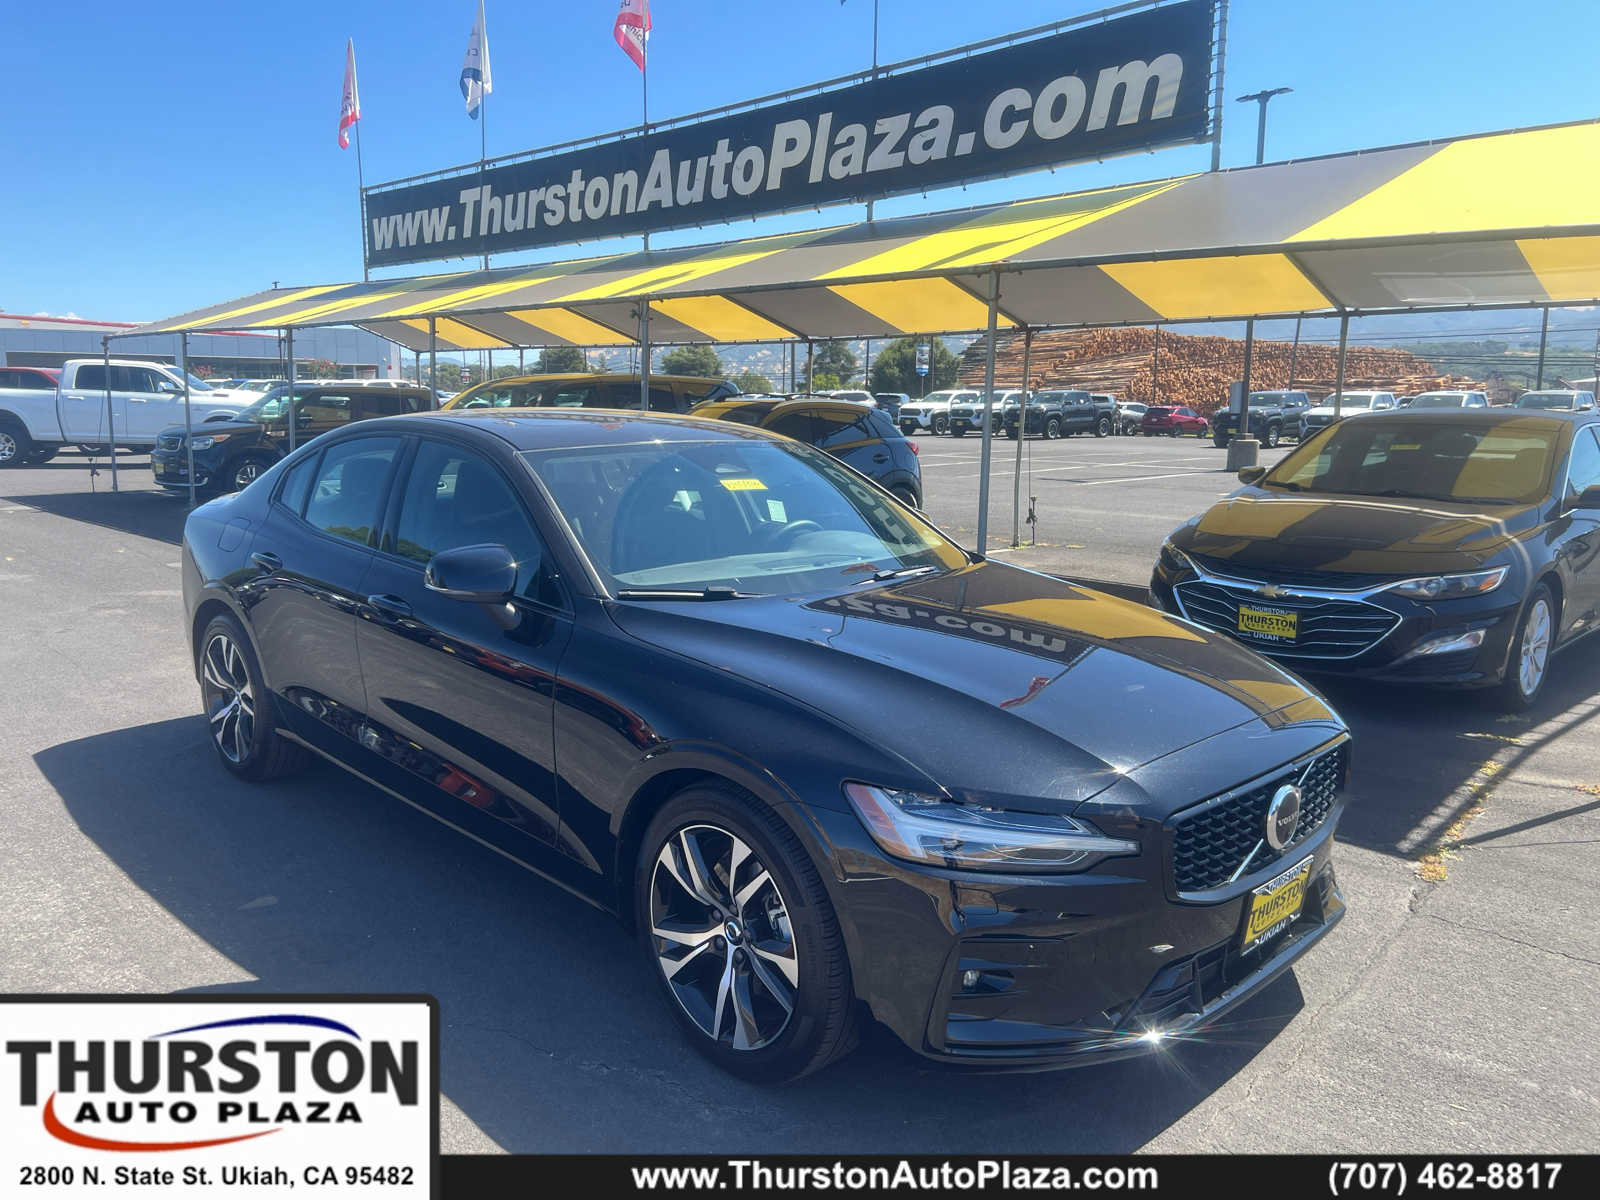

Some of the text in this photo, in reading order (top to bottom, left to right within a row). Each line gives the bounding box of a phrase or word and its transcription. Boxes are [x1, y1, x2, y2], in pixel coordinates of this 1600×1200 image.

[372, 53, 1184, 251] www.ThurstonAutoPlaza.com
[1240, 613, 1296, 630] THURSTON
[1250, 880, 1306, 929] THURSTON
